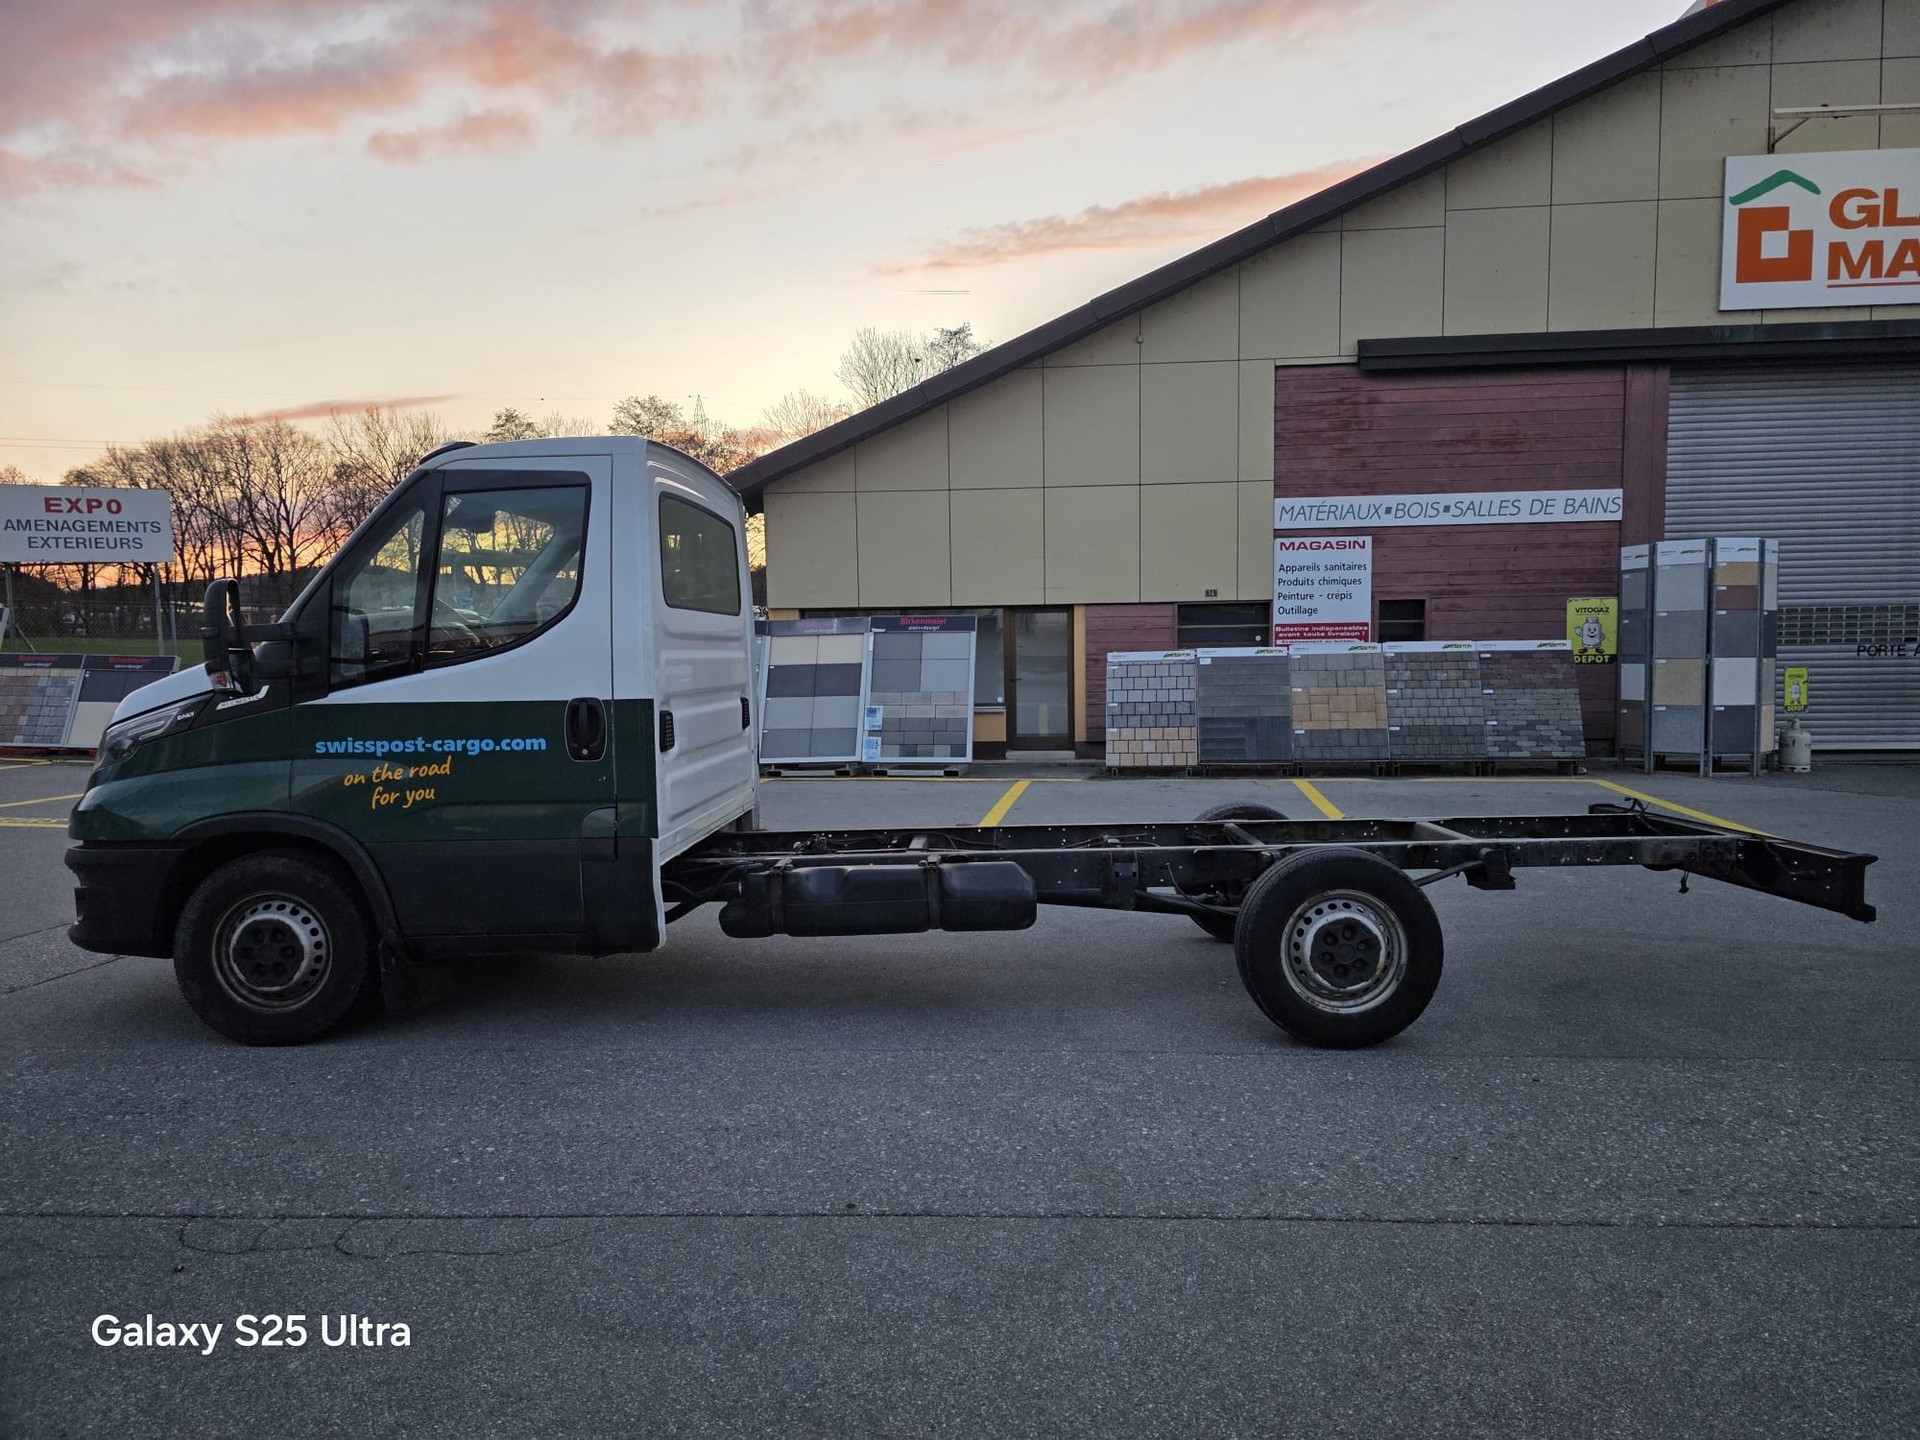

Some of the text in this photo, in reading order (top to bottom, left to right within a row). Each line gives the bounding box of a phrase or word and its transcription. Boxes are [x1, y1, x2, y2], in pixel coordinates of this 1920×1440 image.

[1829, 187, 1920, 229] GL
[44, 497, 122, 515] EXPO
[1279, 497, 1621, 522] MATÉRIAUX BOIS SALLES DE BAINS
[4, 518, 161, 534] AMENAGEMENTS
[28, 536, 143, 550] EXTERIEURS
[1280, 540, 1366, 551] MAGASIN
[1279, 562, 1367, 574] Appareils sanitaires
[1278, 577, 1362, 588] Produits chimiques
[1278, 592, 1315, 601] Peinture
[1327, 591, 1353, 602] crépis
[1278, 605, 1318, 617] Outillage
[1857, 645, 1907, 657] PORTE
[1574, 655, 1610, 663] DEPOT
[177, 710, 195, 720] DAILY
[315, 737, 546, 757] swisspost-cargo.com
[343, 755, 452, 787] on the road
[371, 786, 435, 810] for you
